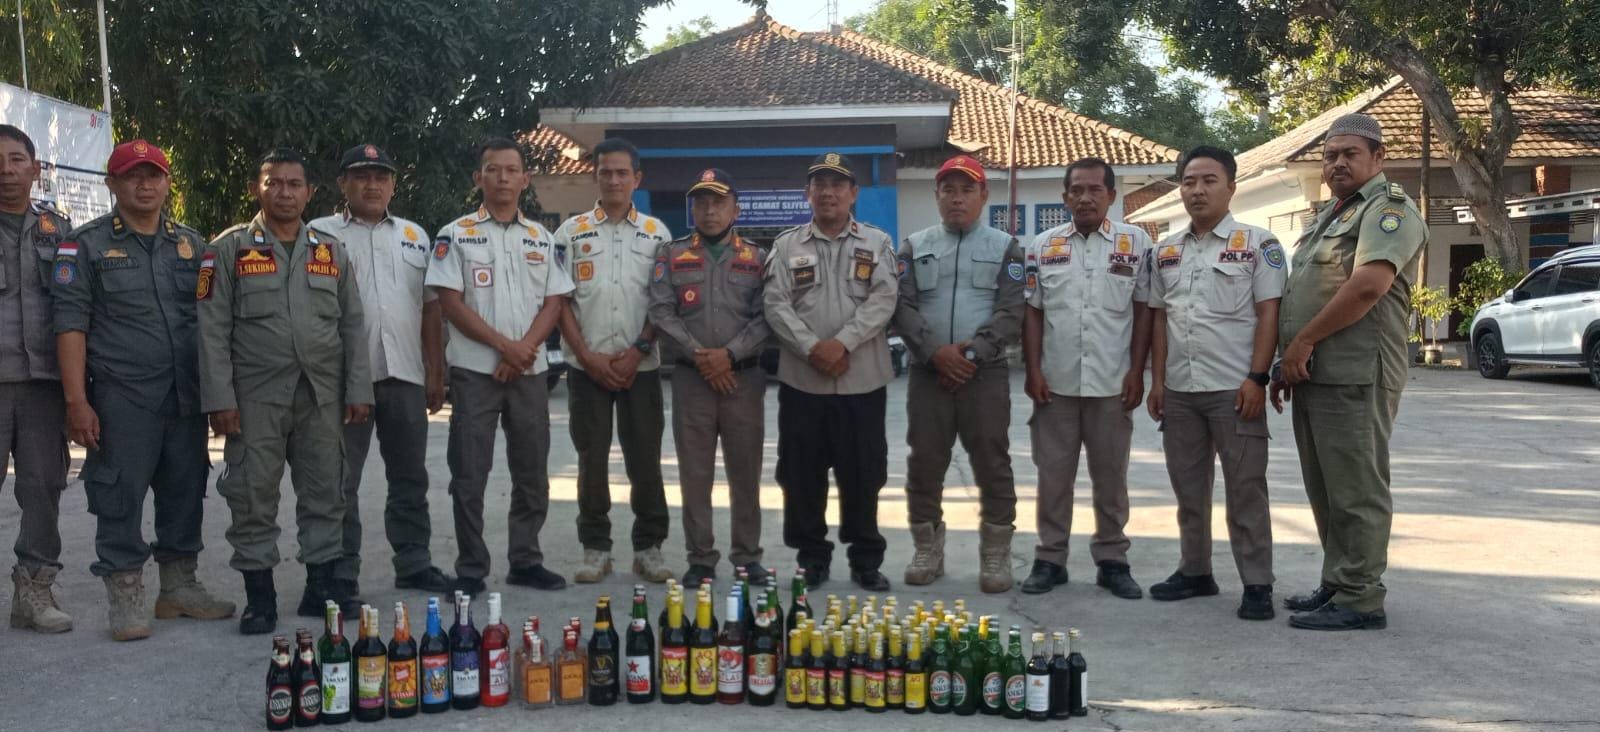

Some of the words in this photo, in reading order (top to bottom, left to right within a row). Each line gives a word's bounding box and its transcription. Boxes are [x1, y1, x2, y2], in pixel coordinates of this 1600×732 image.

[752, 202, 780, 210] CAMAT
[636, 231, 651, 240] POL
[522, 238, 538, 248] POL
[1110, 255, 1126, 263] POL
[1127, 256, 1138, 264] PP
[1220, 251, 1238, 260] POL
[1240, 252, 1253, 260] PP
